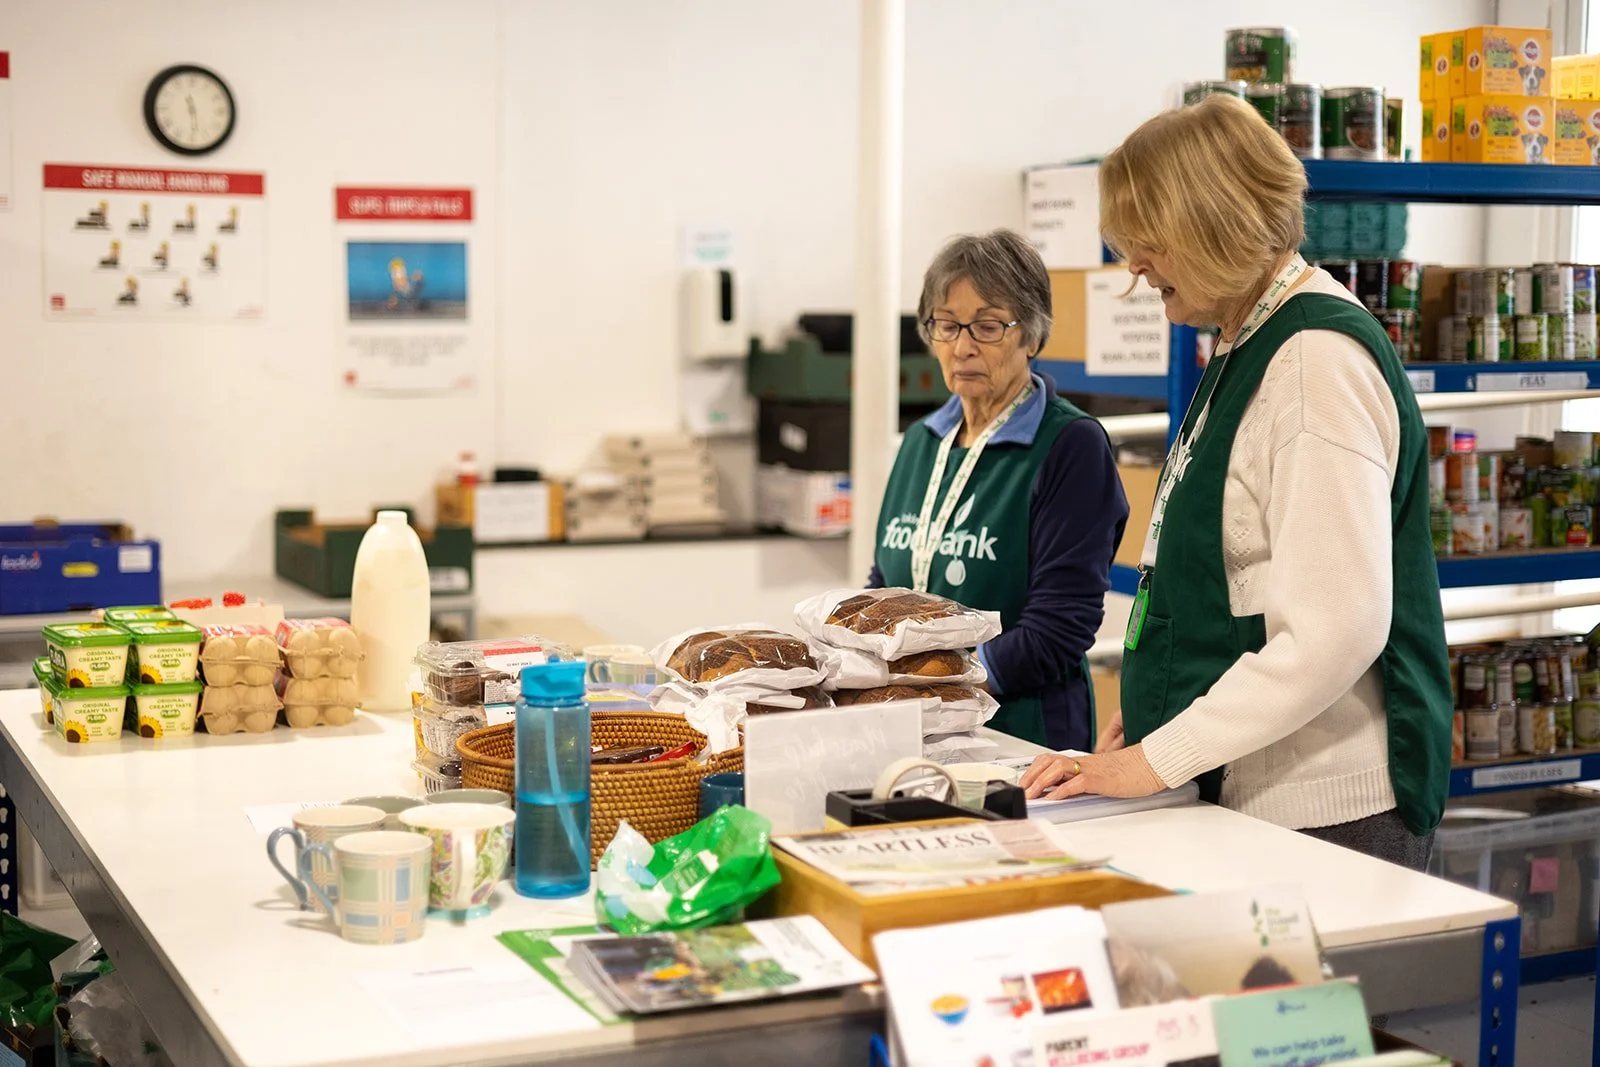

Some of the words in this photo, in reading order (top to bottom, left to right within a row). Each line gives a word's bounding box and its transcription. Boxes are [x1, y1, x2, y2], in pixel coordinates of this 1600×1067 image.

[82, 169, 114, 188] SAFE
[882, 517, 998, 561] fooank
[807, 829, 992, 856] HEARTLESS
[1045, 1036, 1088, 1053] PARENT
